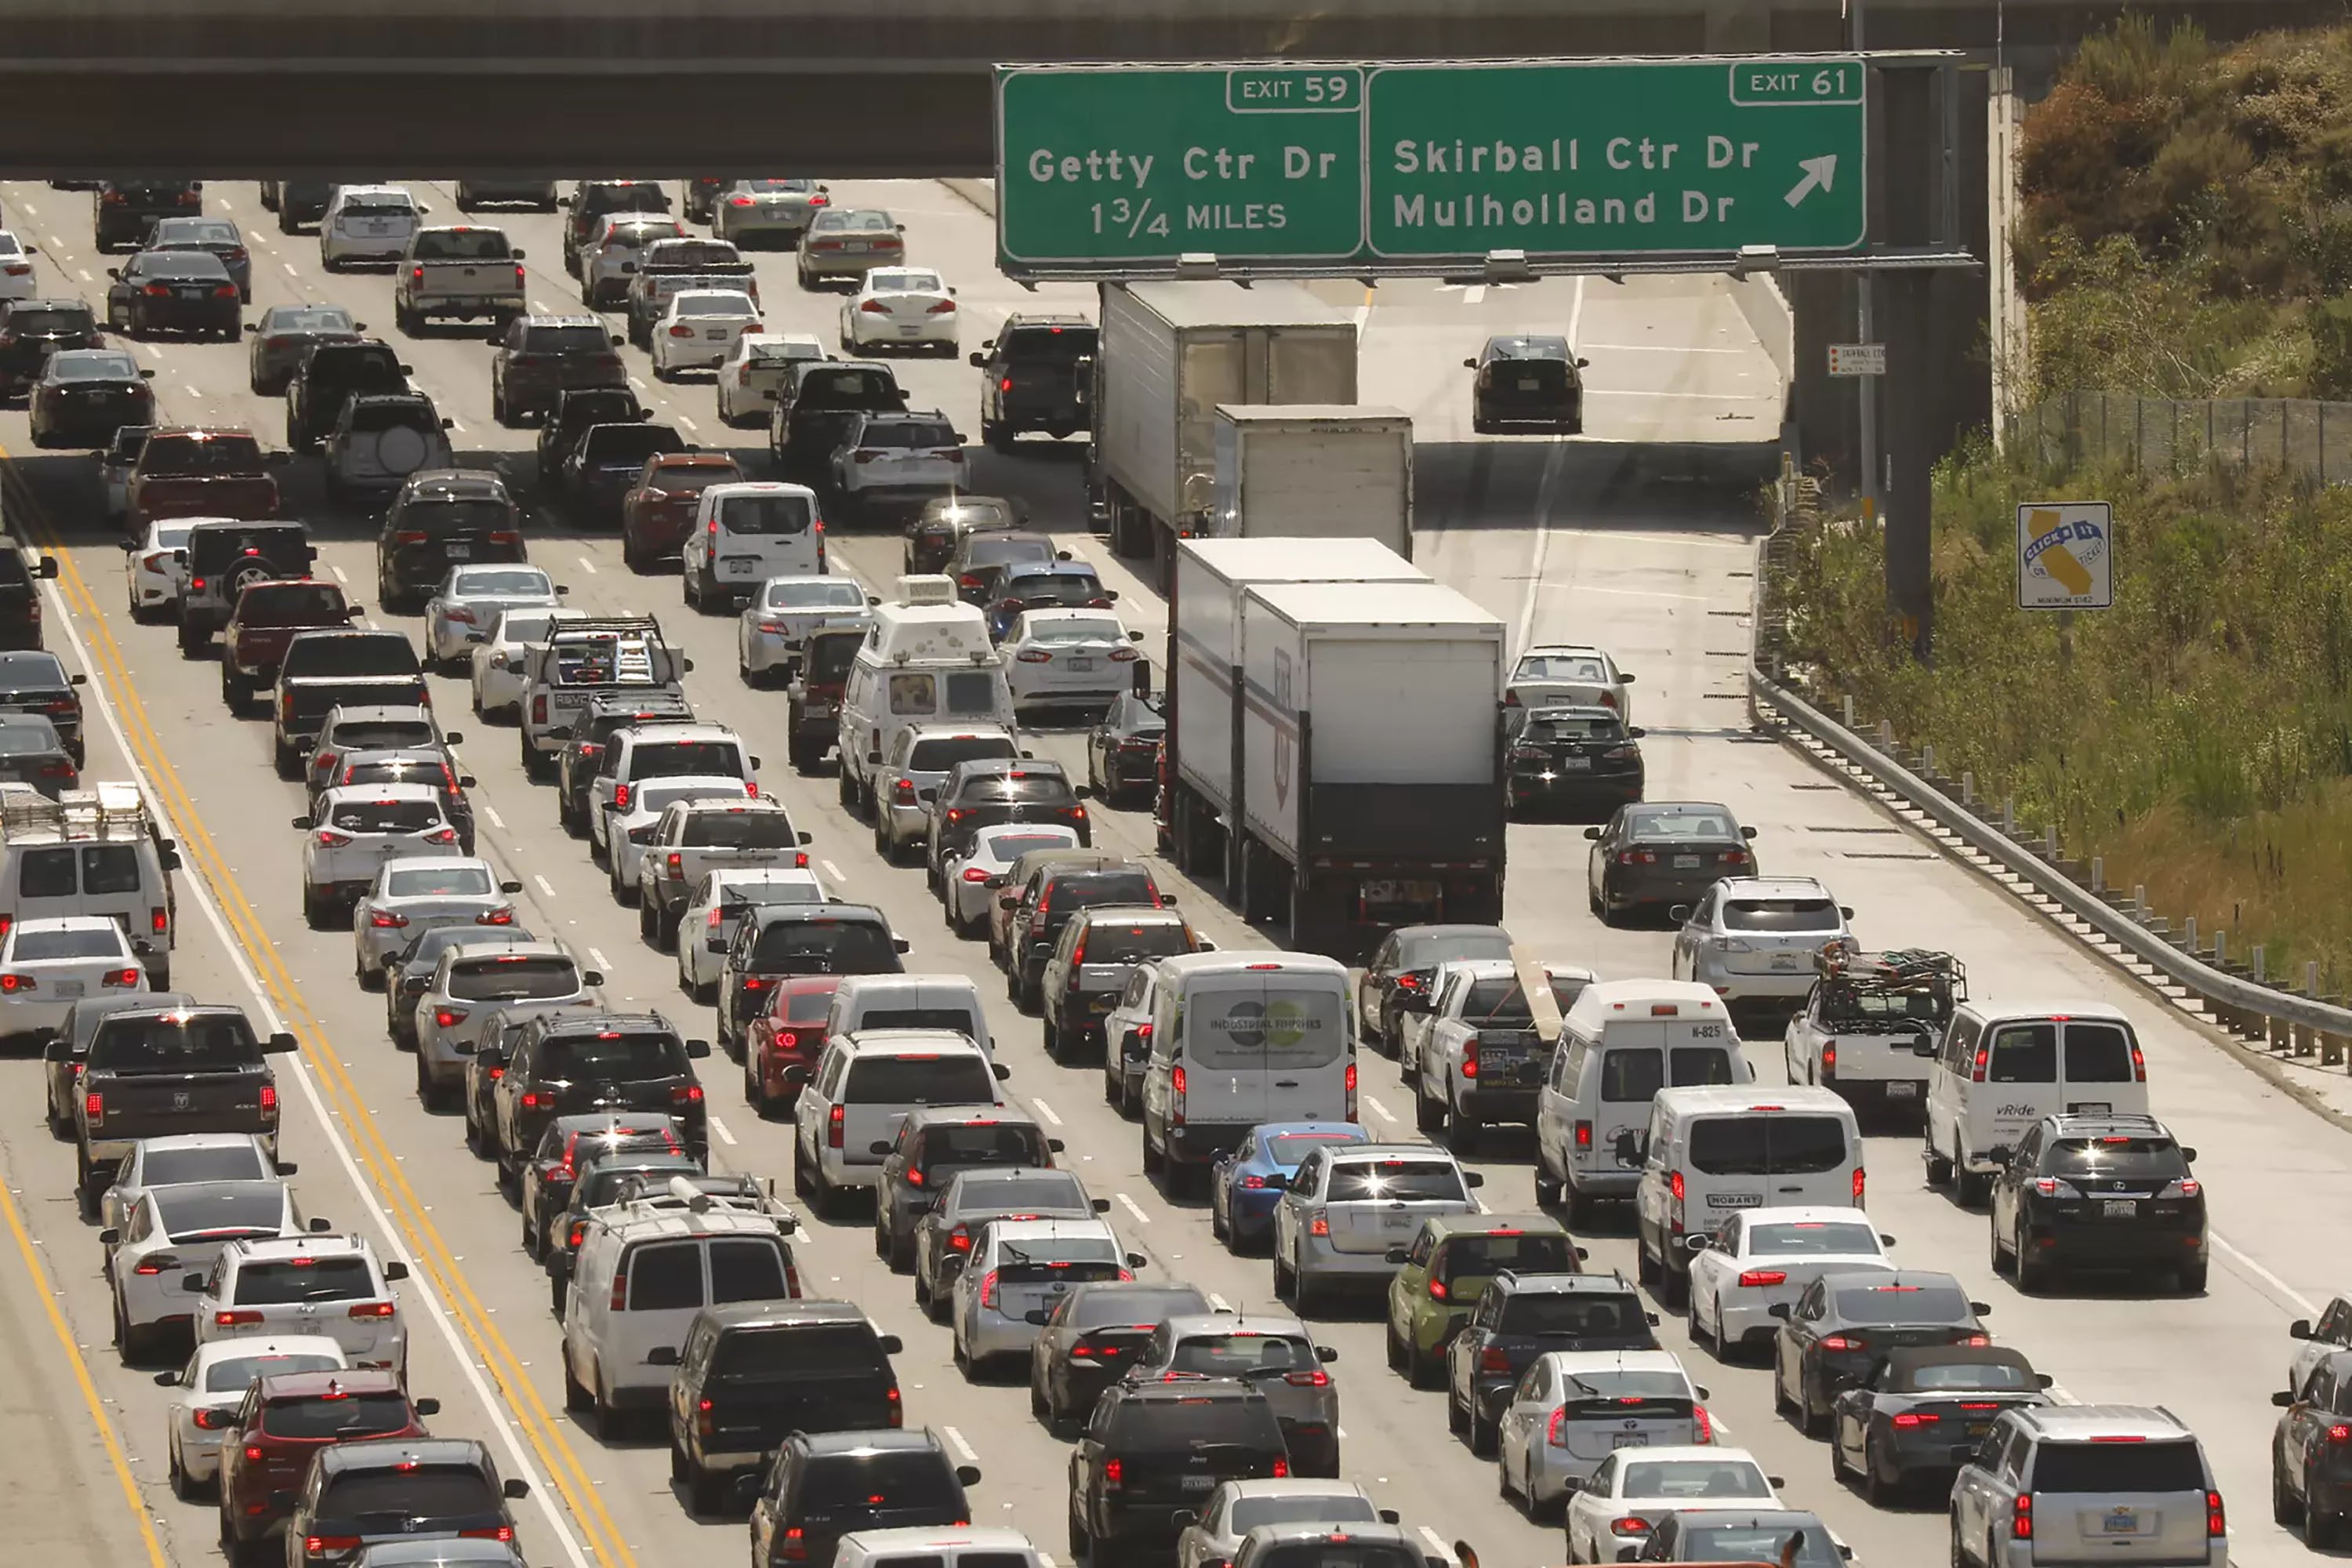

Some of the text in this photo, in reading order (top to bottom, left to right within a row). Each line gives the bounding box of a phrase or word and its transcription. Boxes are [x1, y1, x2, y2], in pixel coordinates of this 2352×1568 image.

[1243, 76, 1347, 102] EXIT 59
[1751, 69, 1845, 95] EXIT 61
[1394, 135, 1759, 173] Skirball Ctr Dr
[1029, 146, 1337, 189] Getty Ctr Dr
[1187, 204, 1287, 230] MILES
[1394, 190, 1734, 227] Mulholland Dr
[2026, 525, 2092, 560] CLICK IT
[2033, 541, 2103, 576] OR TICKET
[1210, 1018, 1272, 1030] INDUSTRIAL
[1692, 1025, 1721, 1038] N-825
[1997, 1104, 2035, 1116] vRide
